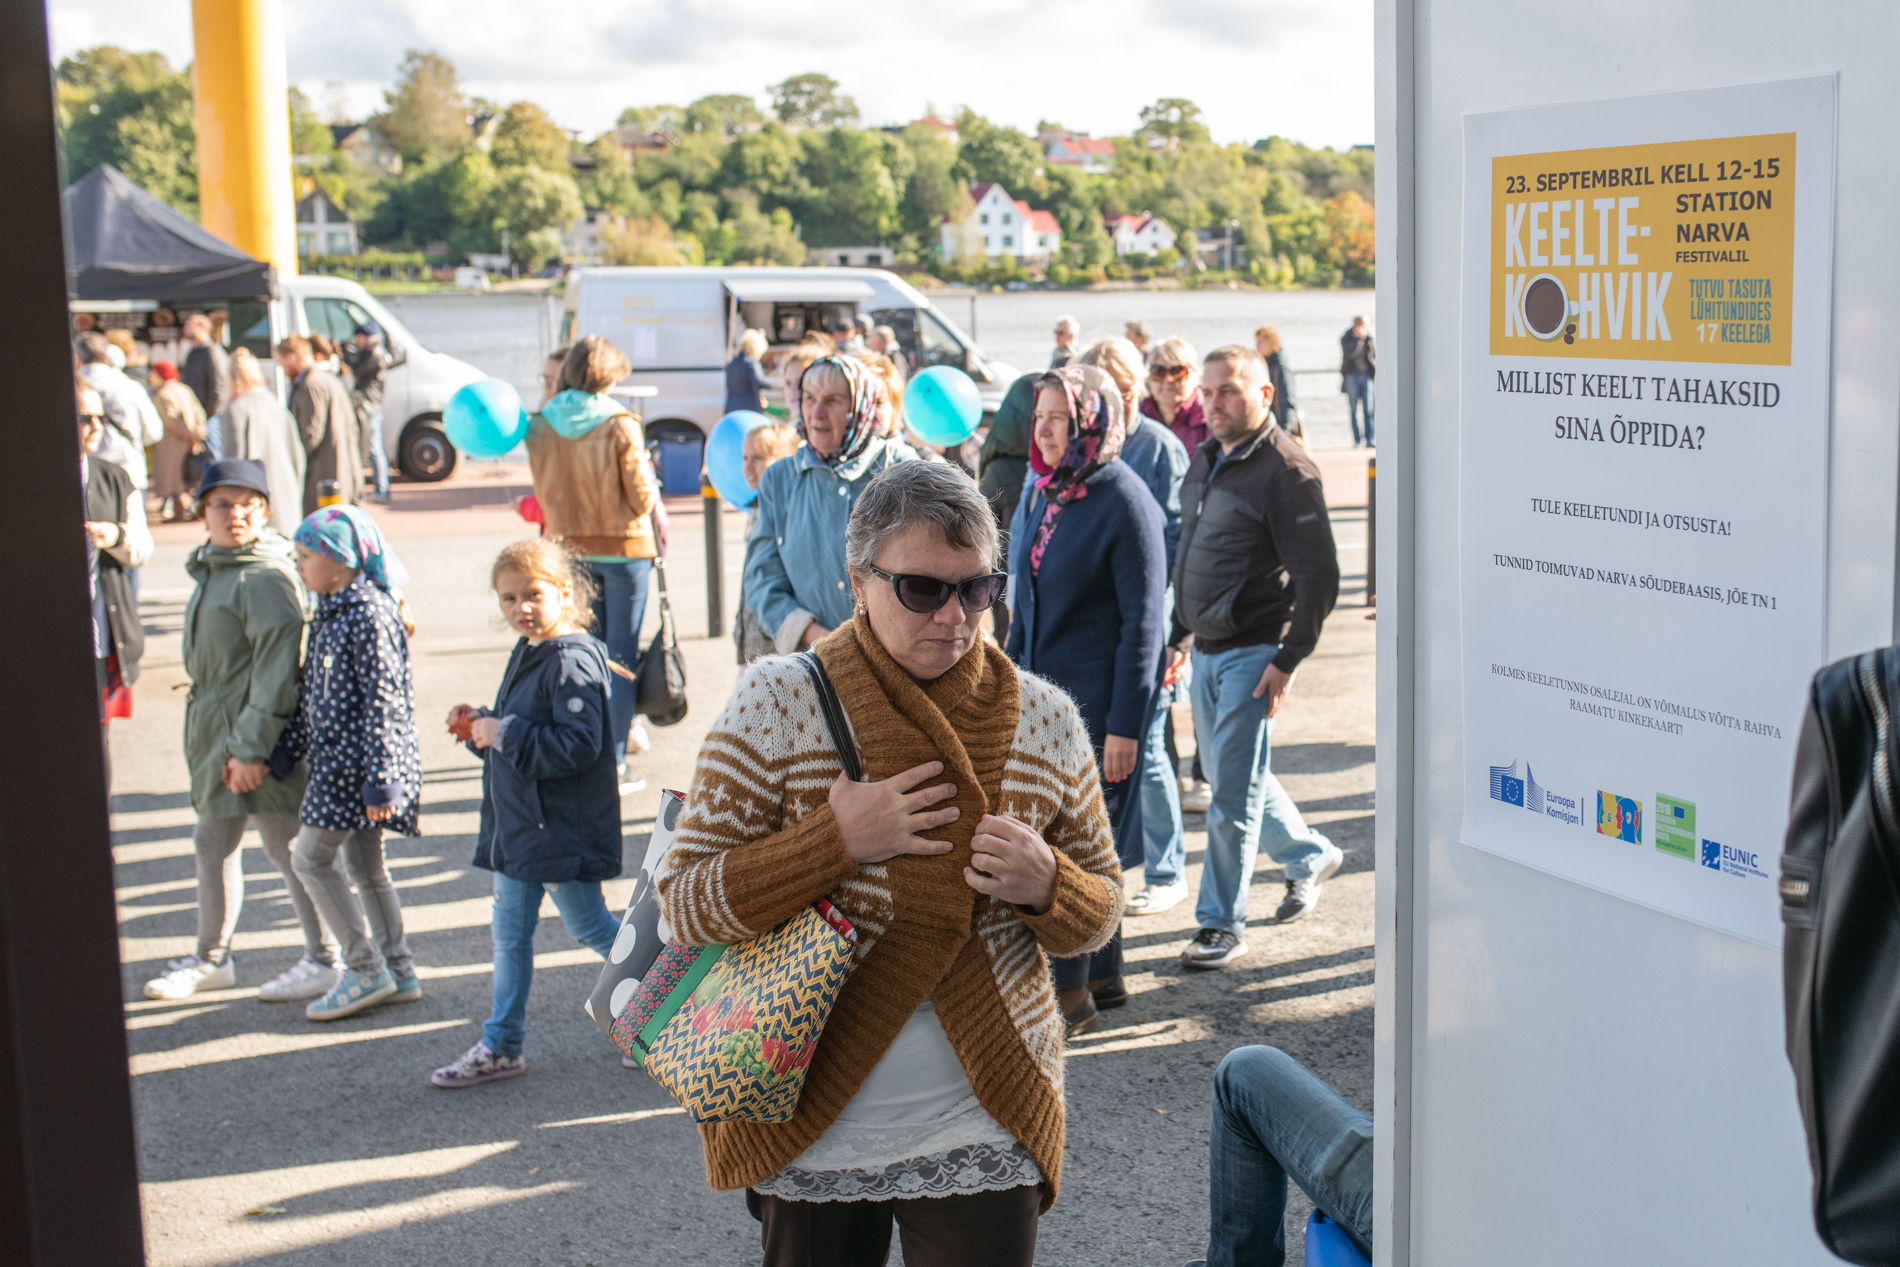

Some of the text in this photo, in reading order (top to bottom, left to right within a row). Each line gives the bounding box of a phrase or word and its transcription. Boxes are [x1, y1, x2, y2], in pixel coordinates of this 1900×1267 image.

[1506, 157, 1780, 194] 23. SEPTEMBRIL KELL 12-15
[1676, 190, 1772, 213] STATION
[1505, 196, 1651, 267] KEELTE-
[1676, 222, 1751, 243] NARVA
[1675, 250, 1750, 263] FESTIVALIL
[1689, 279, 1772, 298] TUTVU TASUTA
[1690, 298, 1771, 321] LÜHITUNDIDES
[1696, 323, 1771, 343] 17 KEELEGA
[1496, 370, 1780, 408] MILLIST KEELT TAHAKSID
[1555, 414, 1706, 450] SINA ÕPPIDA?
[1531, 498, 1732, 536] TULE KEELETUNDI JA OTSUSTA!
[1493, 554, 1777, 610] TUNNID TOIMUVAD NARVA SÕUDEBAASIS, JÕE TN 1
[1491, 663, 1782, 739] KOLMES KEELETUNNIS OSALEJAL ON VÕIMALUS VÕITA RAHVA
[1569, 699, 1684, 735] RAAMATU KINKEKAART!
[1546, 790, 1576, 809] Euroopa
[1656, 801, 1671, 816] 2018
[1546, 805, 1579, 825] Komisjon
[1723, 844, 1759, 869] EUNIC
[1729, 861, 1748, 873] National
[1748, 866, 1769, 879] Institutes
[1729, 868, 1746, 879] Culture
